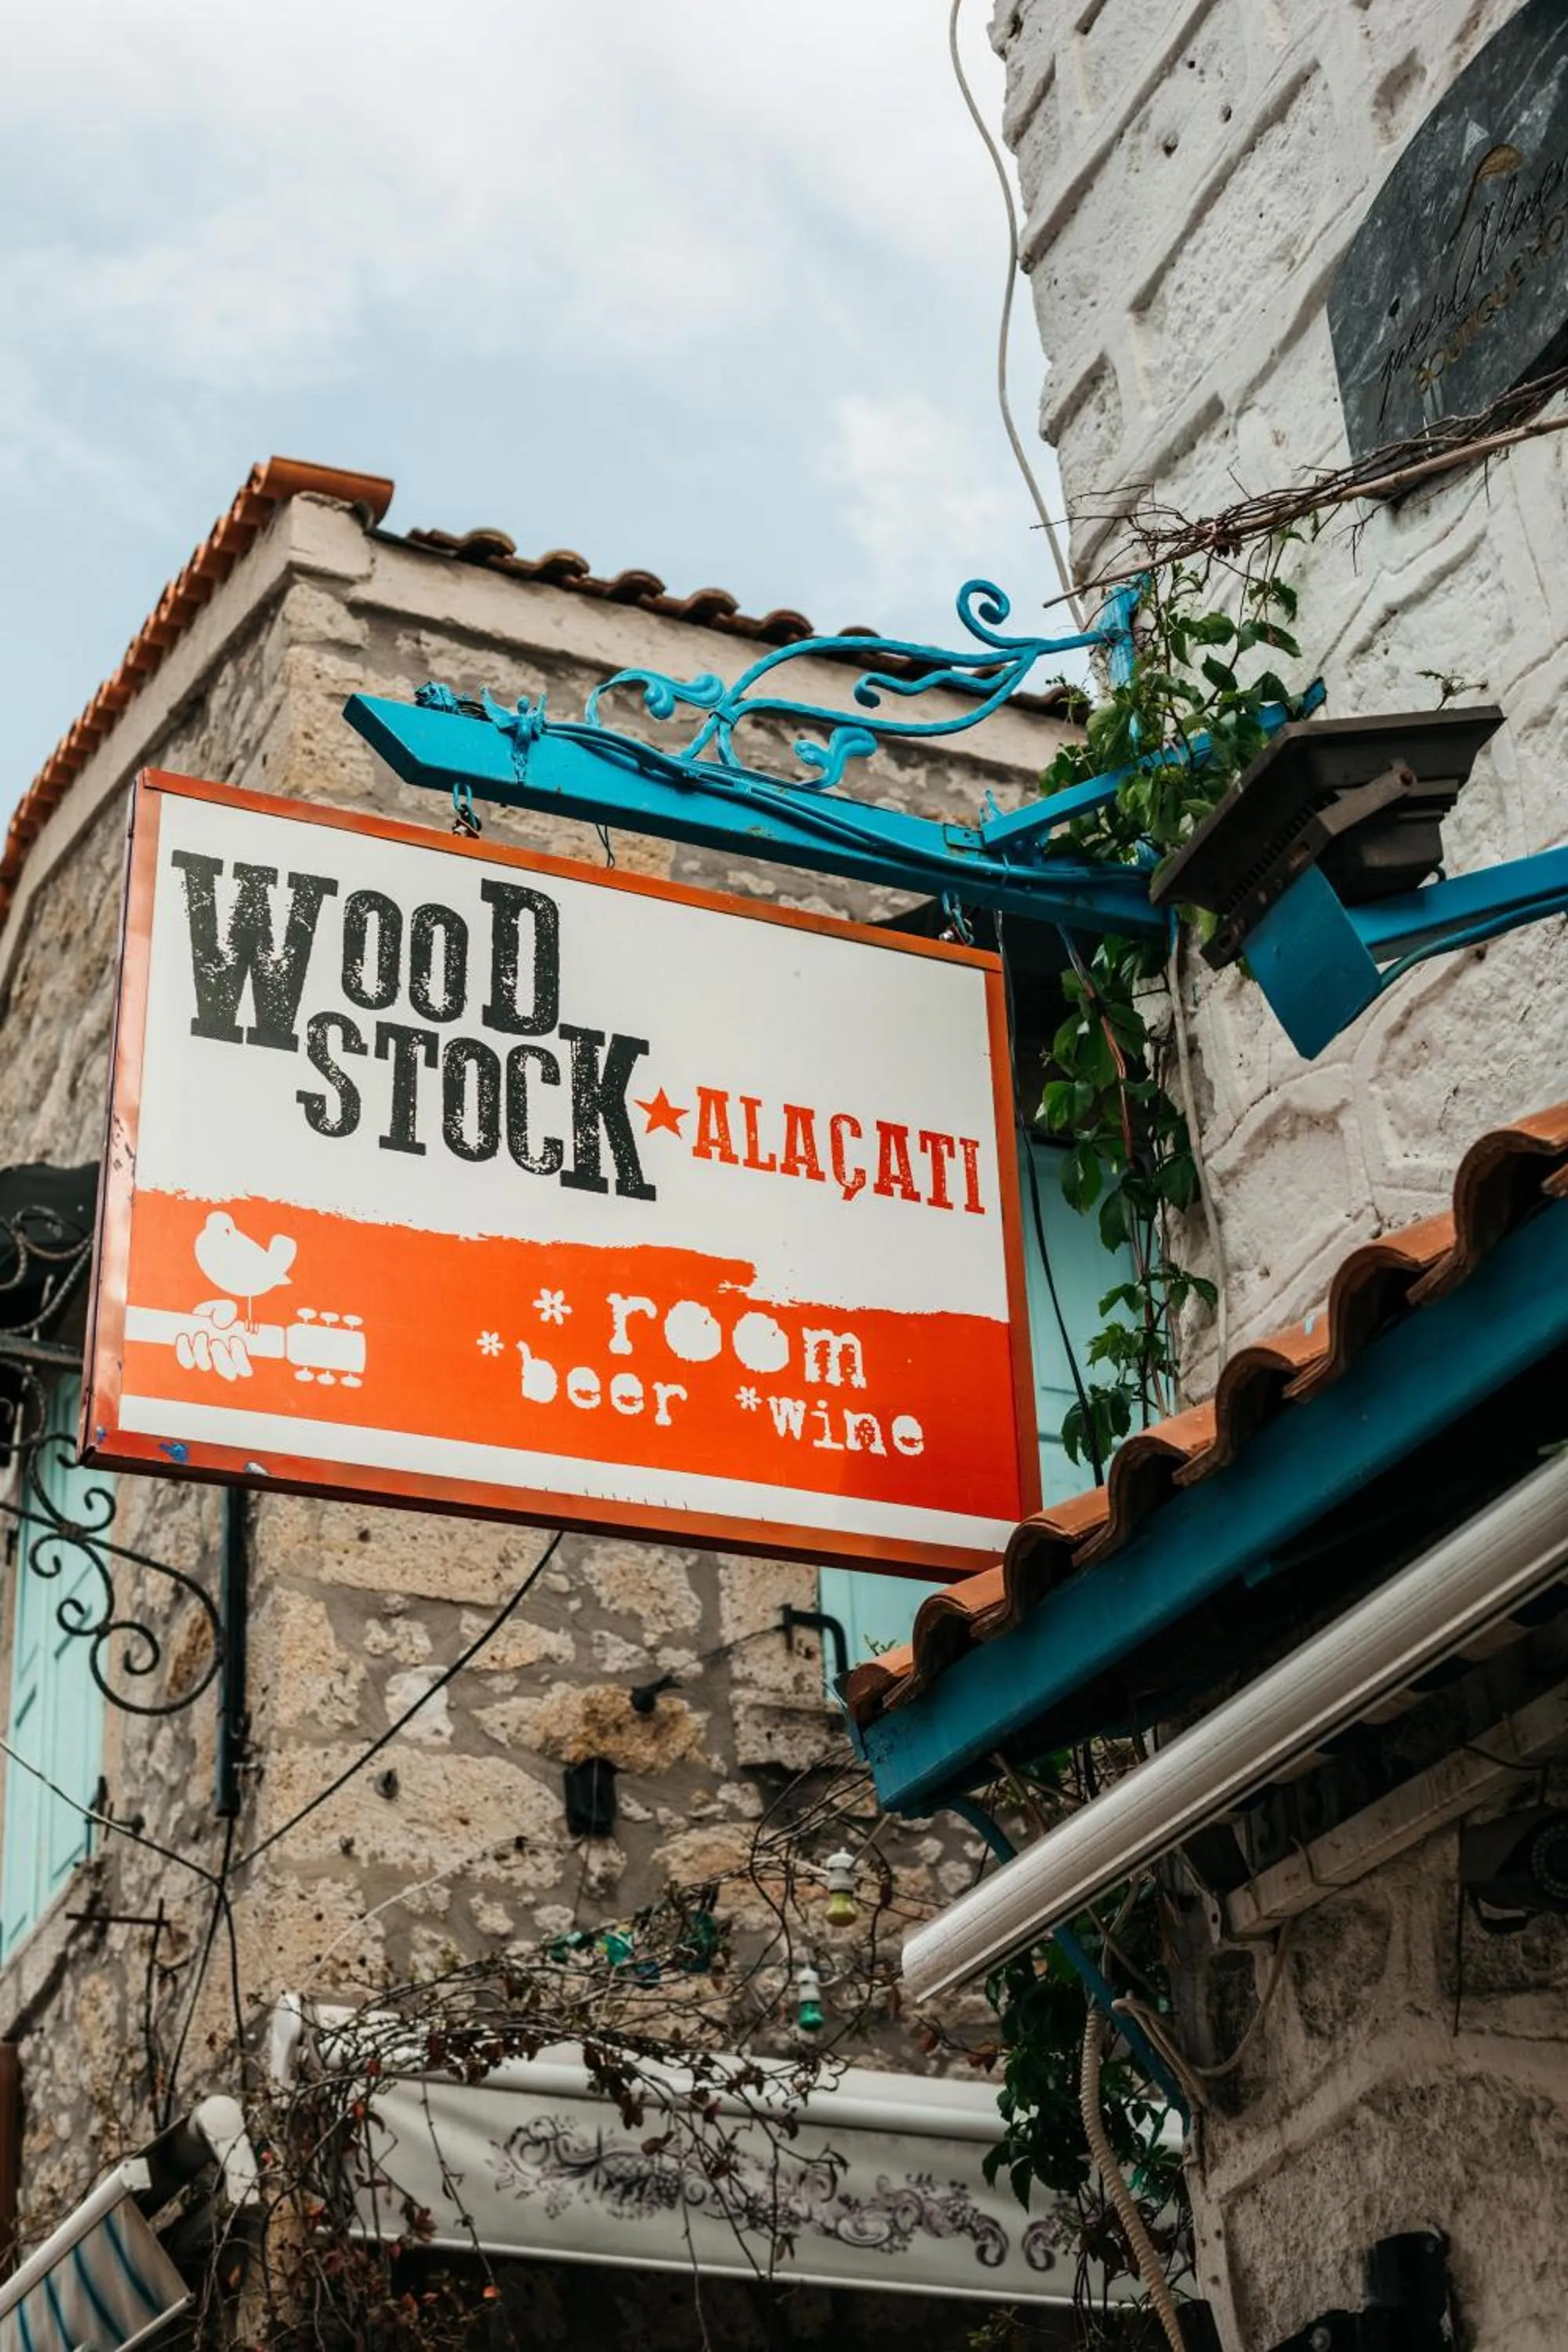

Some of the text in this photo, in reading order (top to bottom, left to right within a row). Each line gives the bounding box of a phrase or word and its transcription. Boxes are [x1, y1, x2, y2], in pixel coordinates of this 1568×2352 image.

[172, 850, 560, 1052] WOOD
[296, 1011, 985, 1214] STOCK ALAÇATI
[517, 1341, 925, 1456] beer wine
[608, 1293, 866, 1388] room
